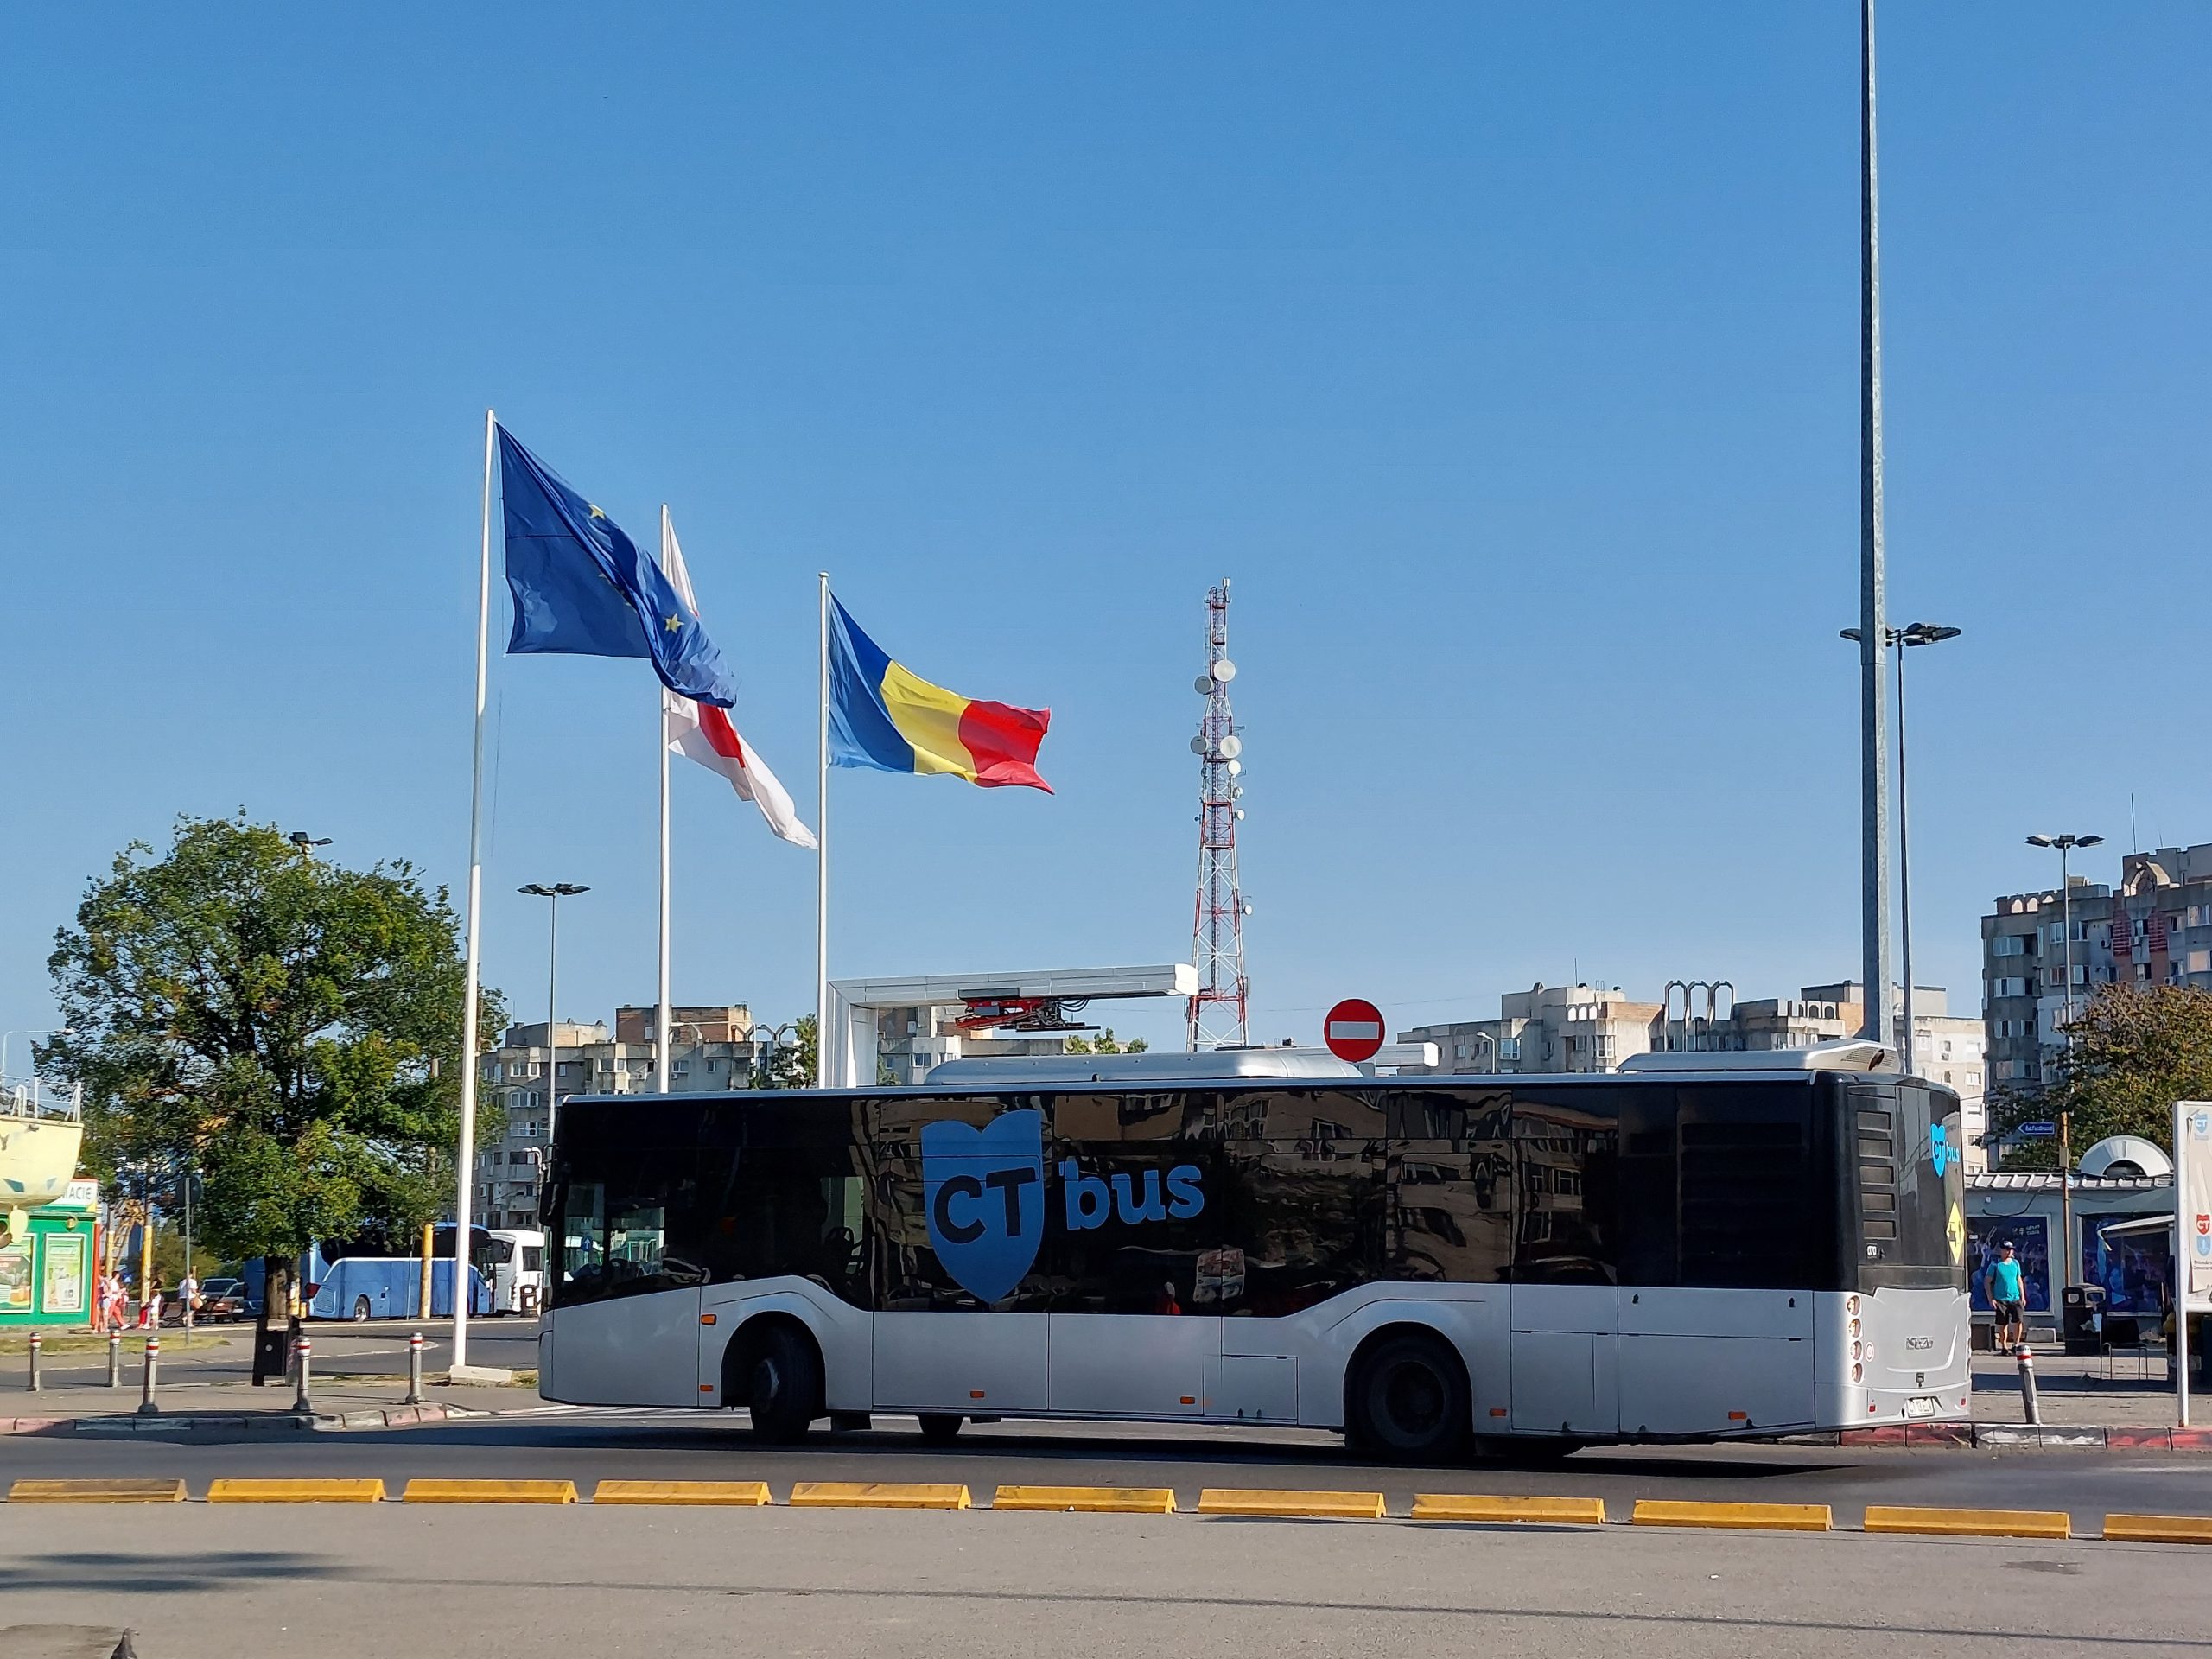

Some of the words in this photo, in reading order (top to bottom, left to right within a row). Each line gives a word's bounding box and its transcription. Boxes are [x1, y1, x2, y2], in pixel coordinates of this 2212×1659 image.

[1933, 1140, 1944, 1160] CT
[1946, 1141, 1960, 1162] bus
[933, 1166, 1038, 1244] CT
[1058, 1156, 1205, 1231] bus
[2196, 1219, 2210, 1229] CT
